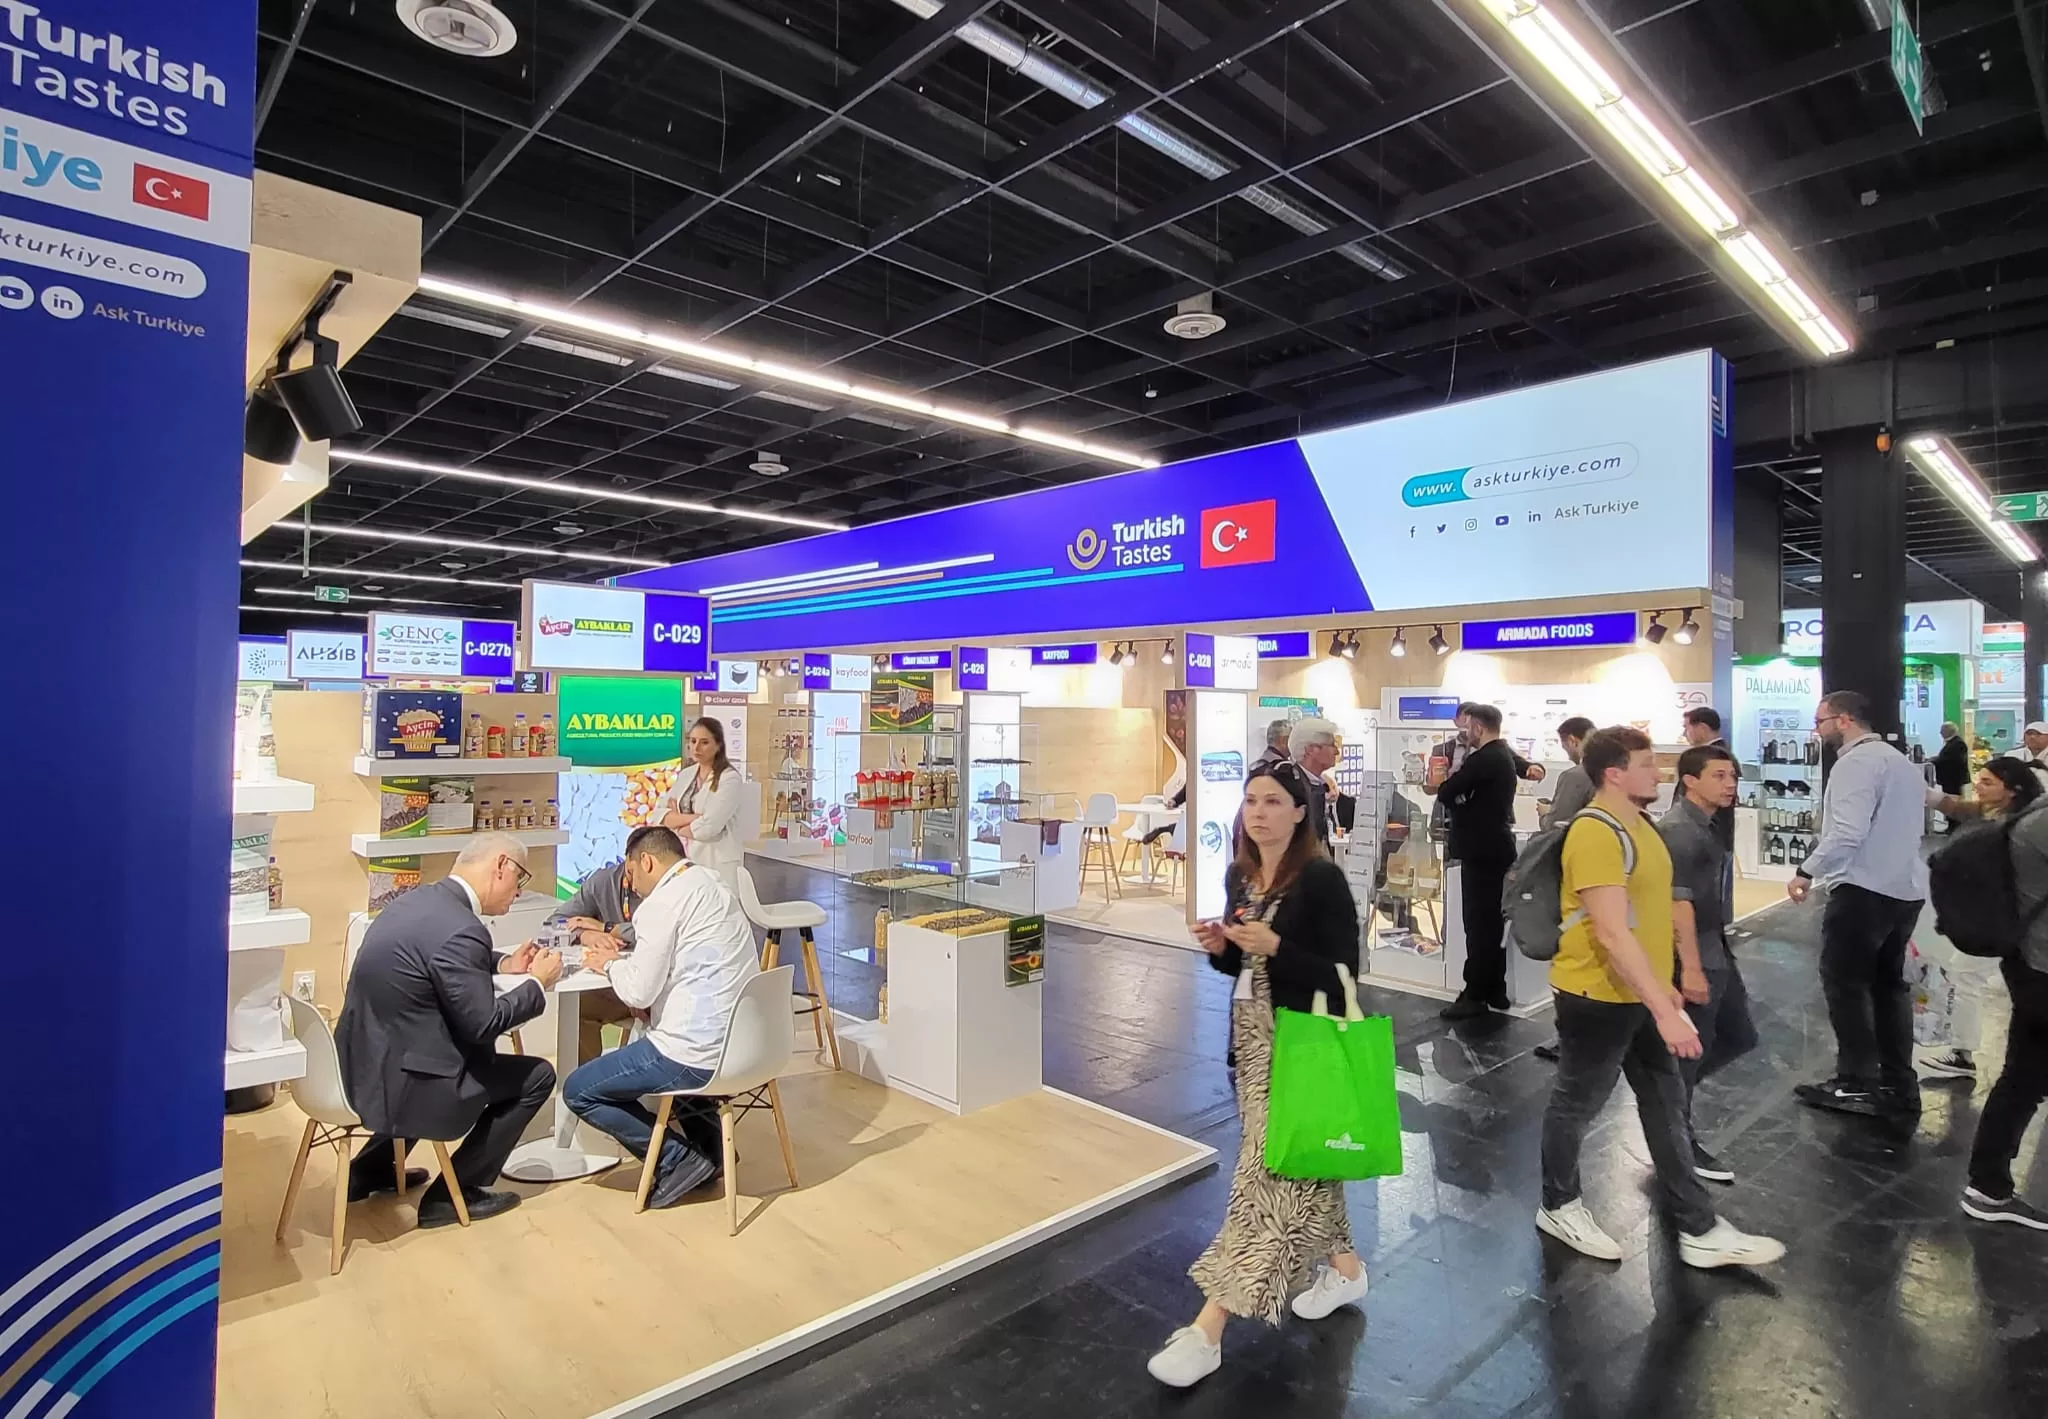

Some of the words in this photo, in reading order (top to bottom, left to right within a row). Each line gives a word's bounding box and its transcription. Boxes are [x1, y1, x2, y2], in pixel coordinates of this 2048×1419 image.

[0, 0, 226, 107] Turkish
[0, 42, 188, 136] Tastes
[93, 303, 130, 322] Ask
[133, 310, 206, 337] Turkiye
[1473, 456, 1621, 488] askturkiye.com
[1554, 505, 1580, 520] Ask
[1583, 499, 1640, 516] Turkiye
[1112, 514, 1185, 543] Turkish
[1112, 543, 1171, 567] Tastes
[576, 619, 632, 632] AYBAKLAR
[653, 622, 701, 644] C-029
[1497, 625, 1549, 641] ARMADA
[1550, 623, 1594, 638] FOODS
[465, 641, 512, 657] C-027b
[1258, 640, 1278, 652] GIDA
[805, 666, 830, 677] C-024a
[835, 667, 869, 679] kayfood
[962, 663, 985, 674] C-026
[566, 713, 675, 731] AYBAKLAR
